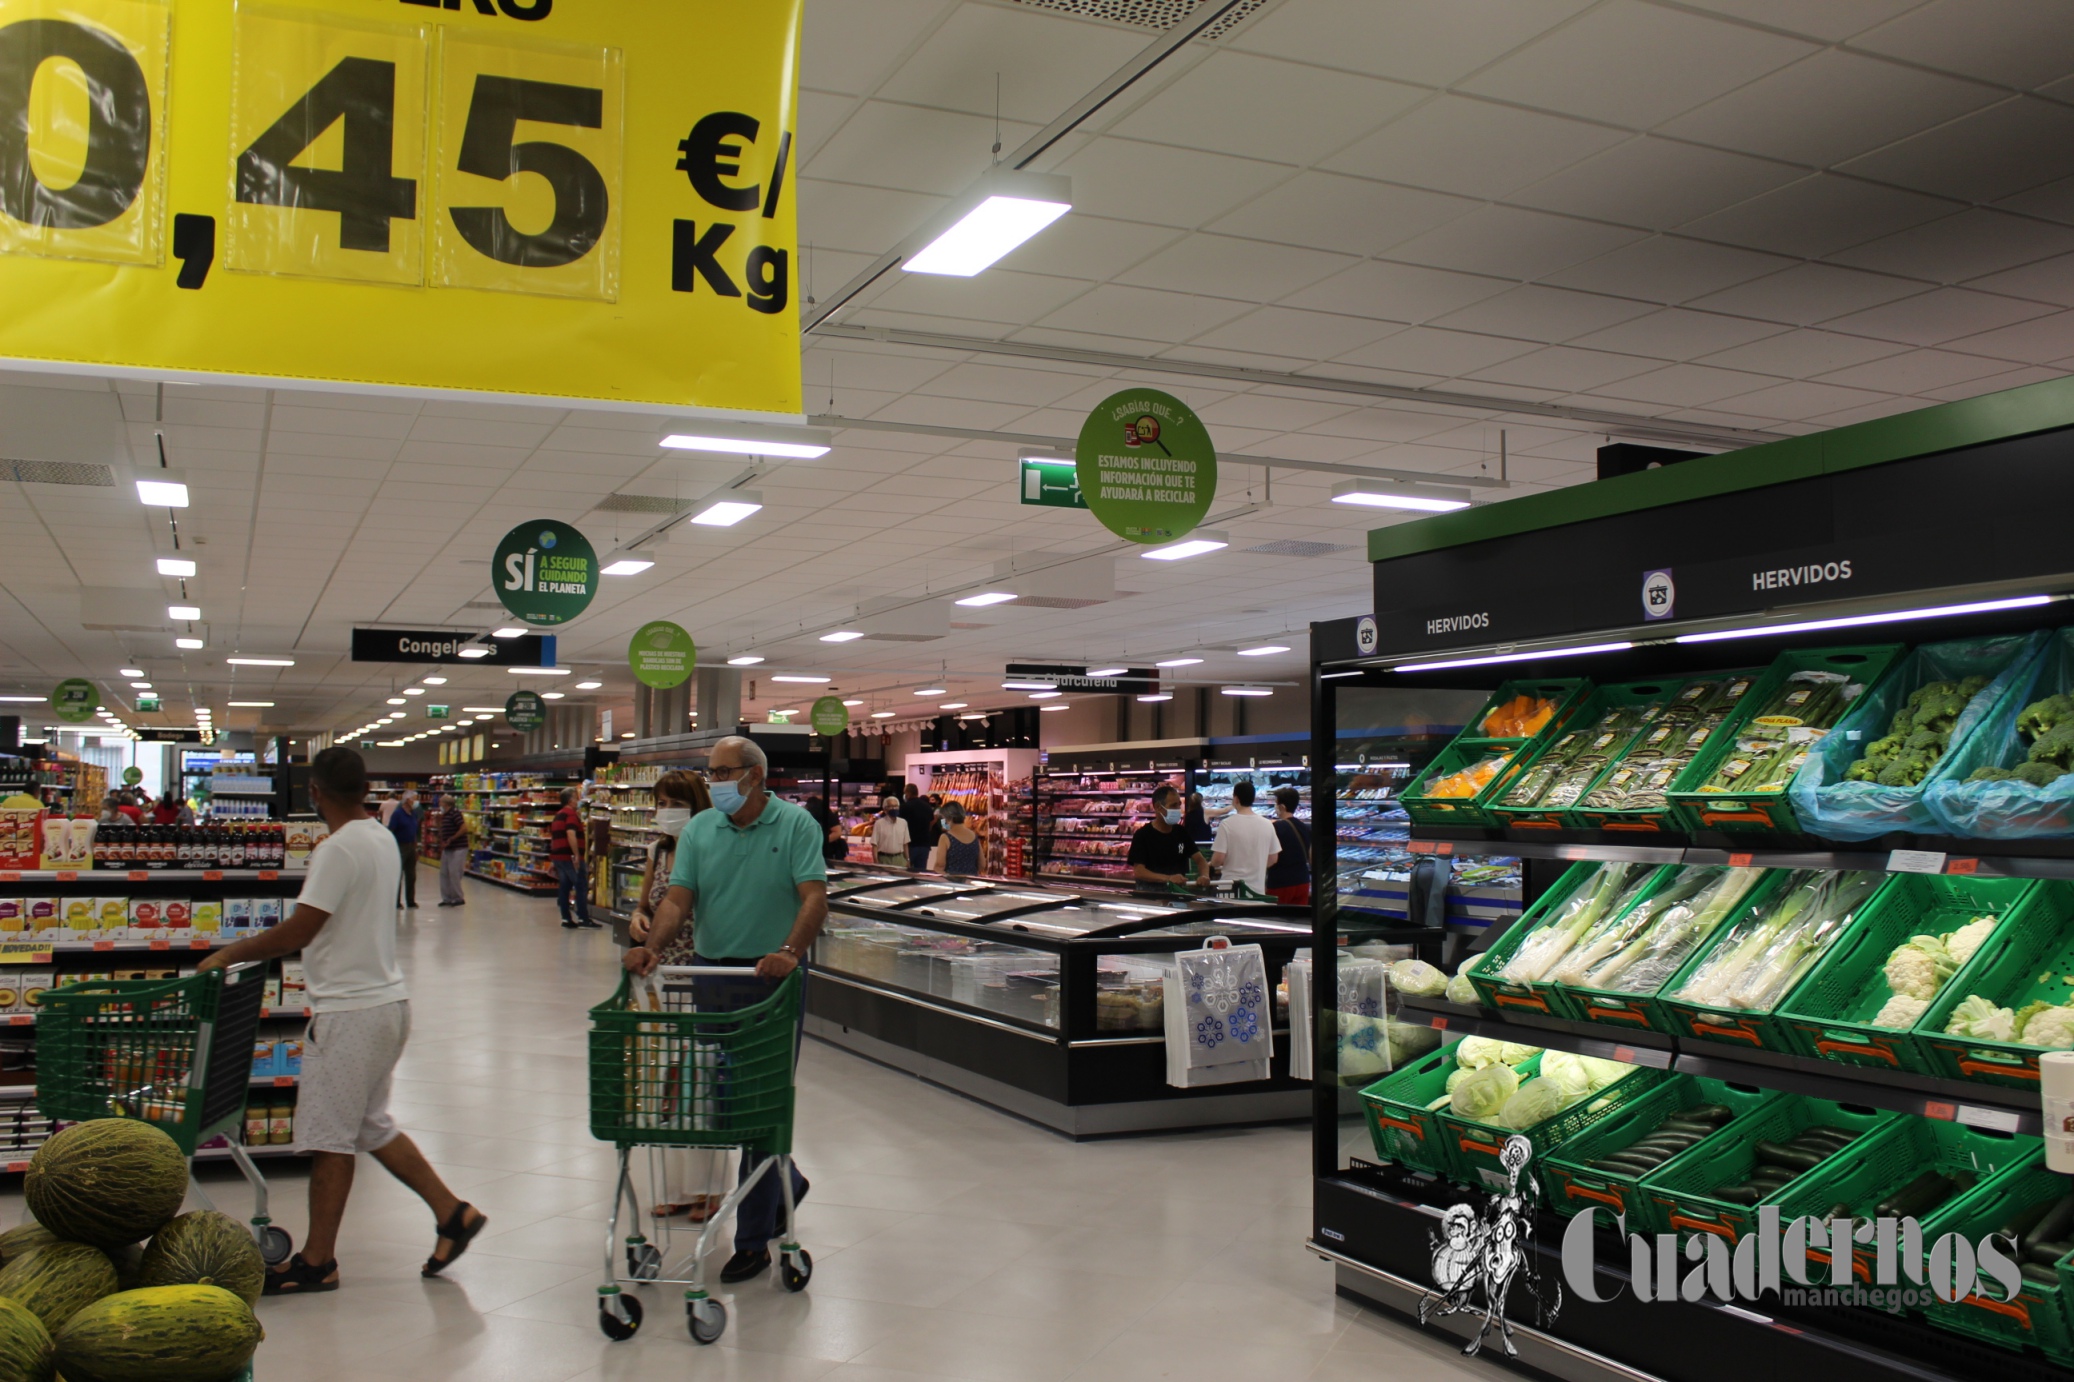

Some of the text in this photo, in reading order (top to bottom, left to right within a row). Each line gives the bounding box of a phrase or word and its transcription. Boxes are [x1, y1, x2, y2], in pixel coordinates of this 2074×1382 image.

[671, 218, 788, 314] Kg
[1098, 454, 1197, 473] ESTAMOS INCLUYENDO
[1100, 470, 1195, 489] INFORMACIÓN QUE TE
[1100, 486, 1196, 504] AYUDARÁ A RECICLAR
[505, 547, 538, 591] SÍ
[540, 556, 587, 571] A SEGUIR
[539, 569, 587, 583] CUIDANDO
[1752, 560, 1852, 591] HERVIDOS
[539, 582, 586, 595] EL PLANETA
[1427, 612, 1489, 635] HERVIDOS
[398, 637, 497, 658] Congels
